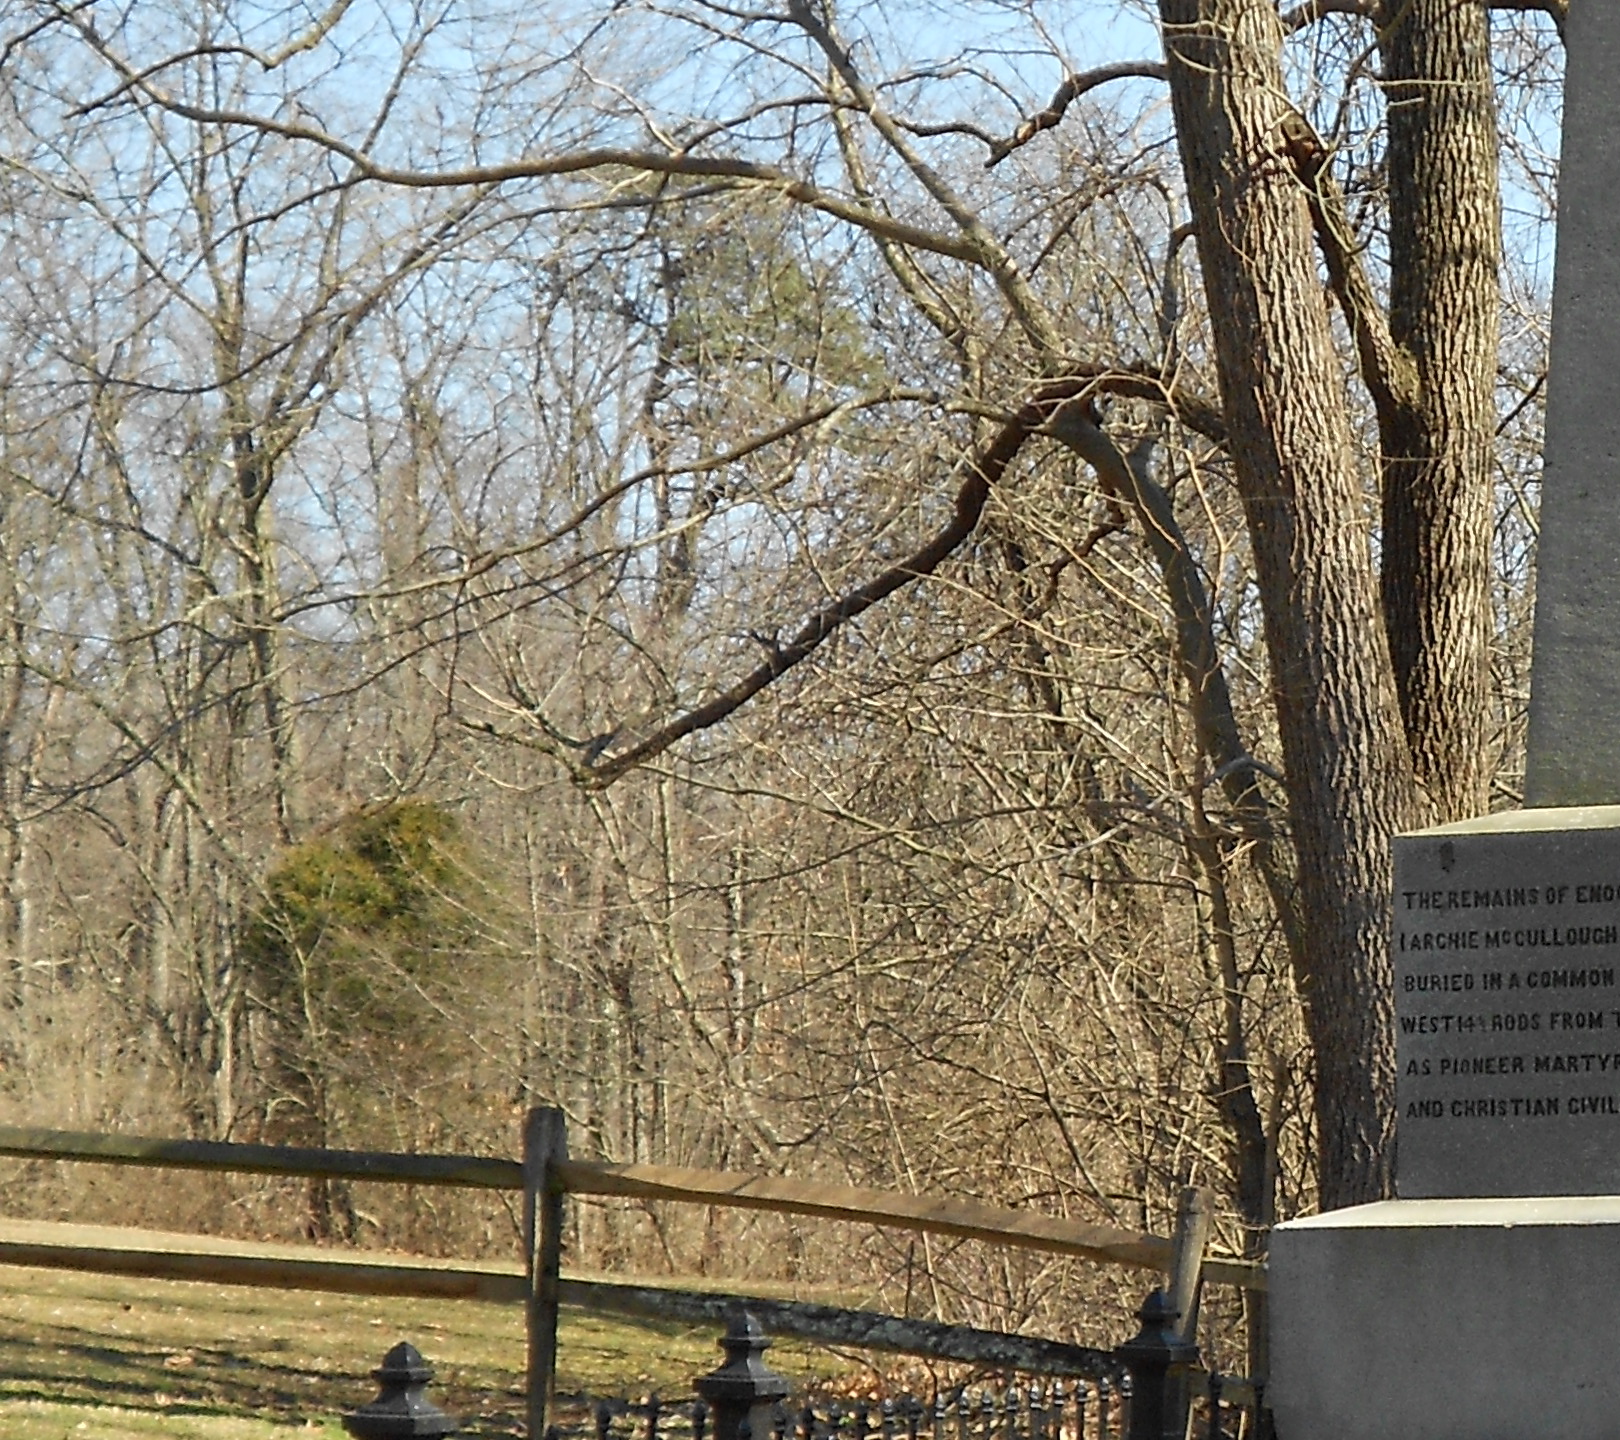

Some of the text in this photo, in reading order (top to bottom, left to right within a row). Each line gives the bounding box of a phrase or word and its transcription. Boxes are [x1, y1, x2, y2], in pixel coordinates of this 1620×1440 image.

[1403, 891, 1442, 909] THE
[1448, 888, 1538, 908] REMAINS
[1546, 886, 1569, 905] OF
[1400, 931, 1479, 952] (ARCHIE
[1404, 974, 1474, 992] BURIED
[1483, 972, 1501, 990] IN
[1508, 973, 1521, 990] A
[1527, 968, 1614, 989] COMMON
[1401, 1013, 1455, 1034] WEST
[1492, 1013, 1540, 1032] RODS
[1550, 1011, 1603, 1031] FROM
[1406, 1058, 1431, 1076] AS
[1440, 1056, 1524, 1076] PIONEER
[1406, 1100, 1443, 1119] AND
[1451, 1097, 1559, 1117] CHRISTIAN
